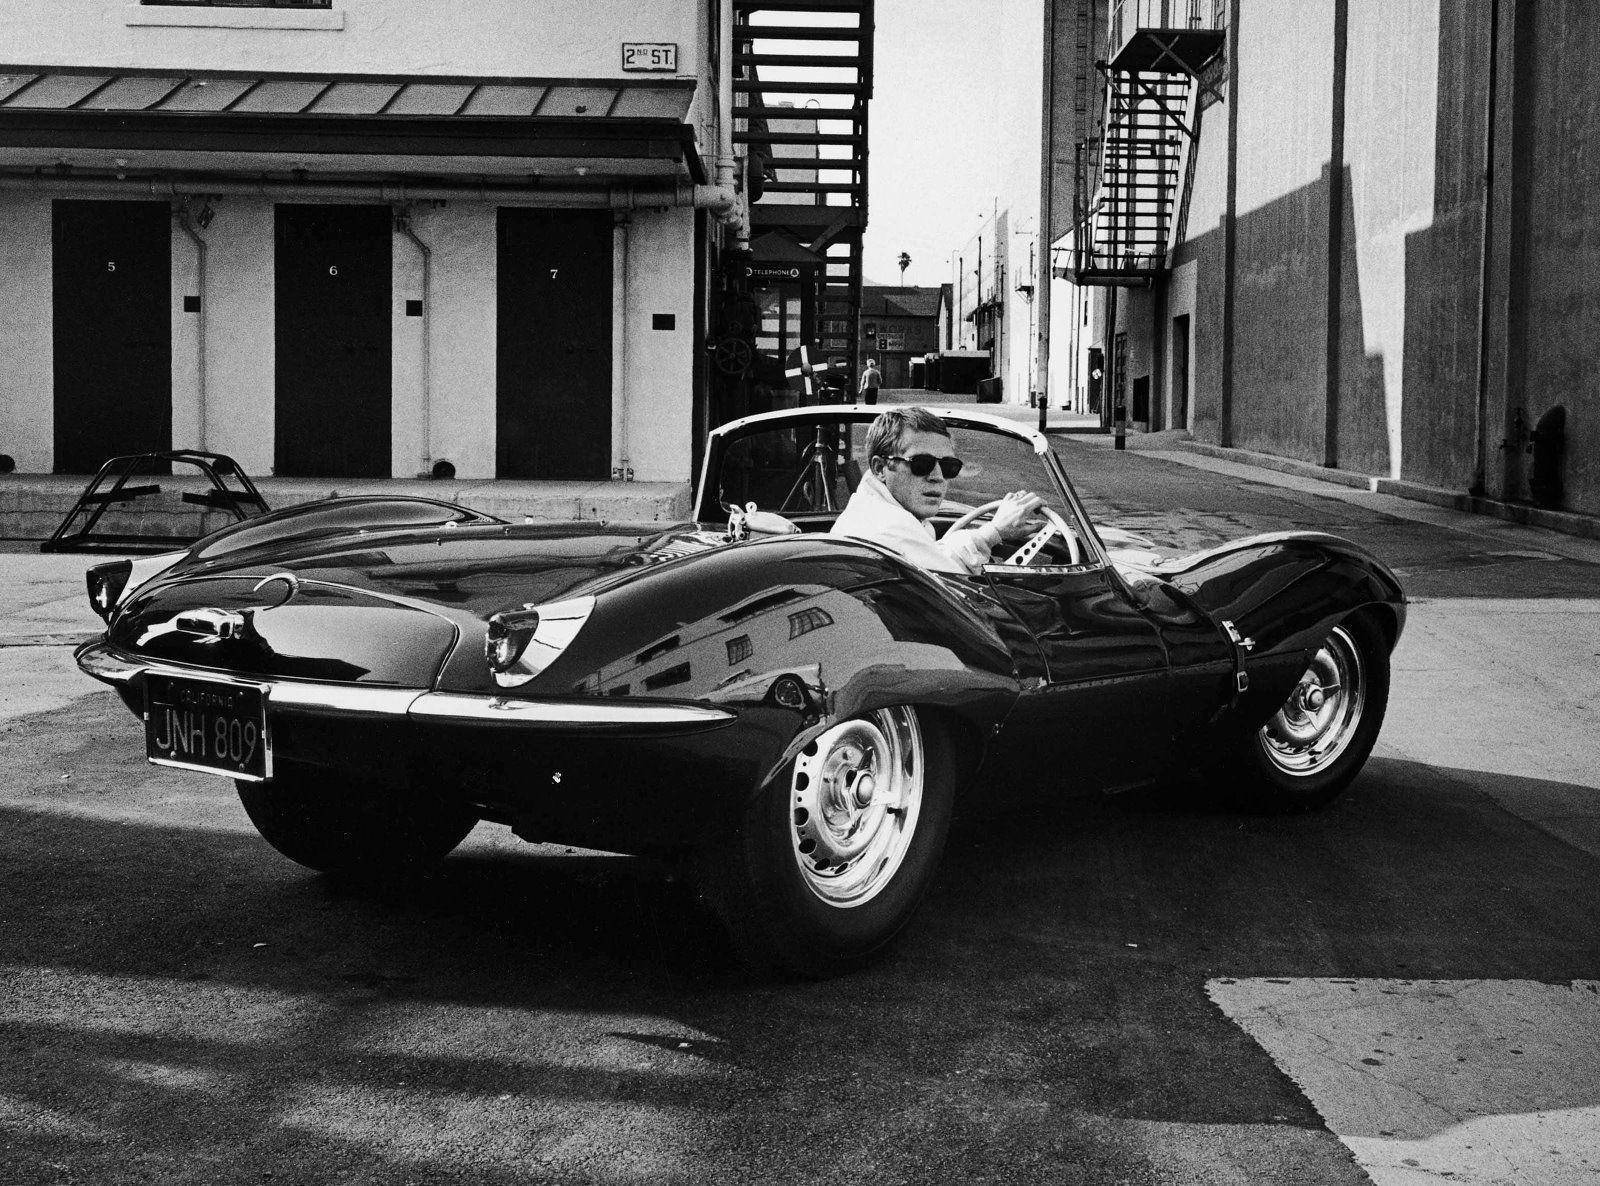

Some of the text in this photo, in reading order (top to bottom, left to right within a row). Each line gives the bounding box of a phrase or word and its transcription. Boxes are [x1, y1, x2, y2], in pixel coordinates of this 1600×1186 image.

[626, 49, 673, 64] 2ND ST.
[107, 261, 116, 272] 5
[329, 265, 338, 276] 6
[550, 269, 559, 279] 7
[156, 709, 256, 764] JNH 809
